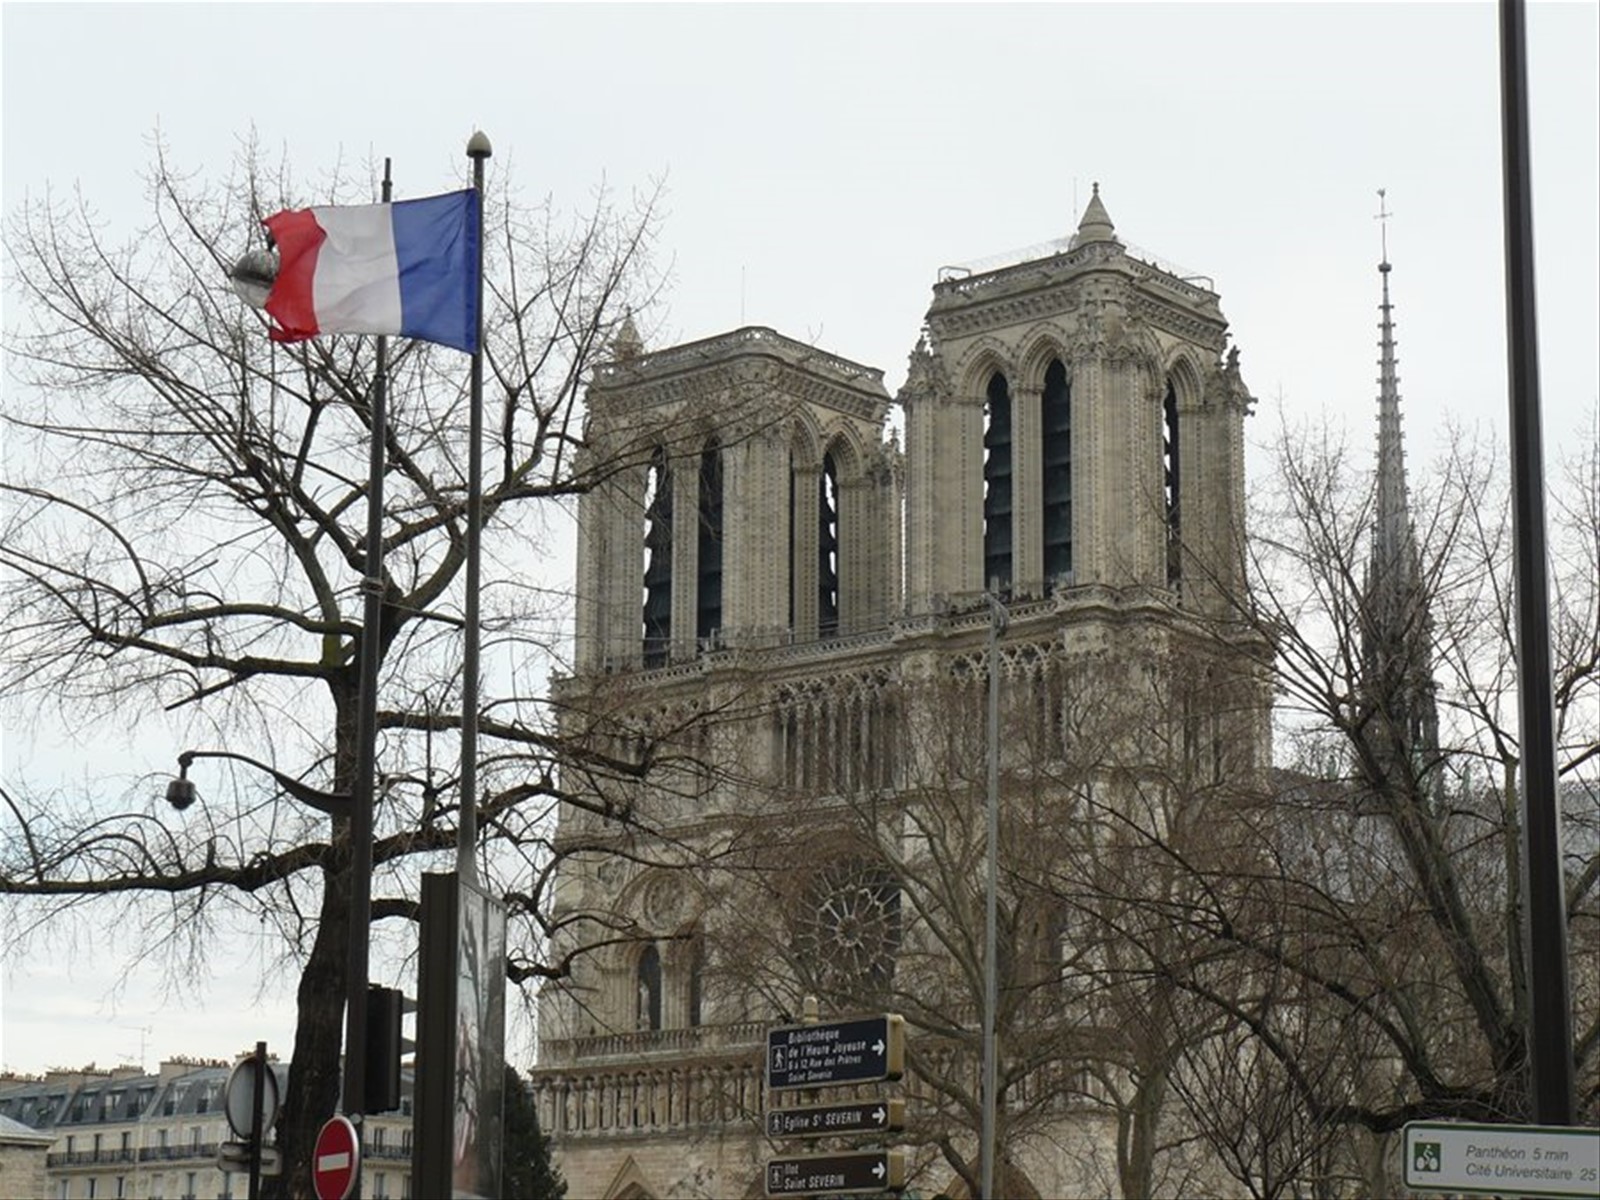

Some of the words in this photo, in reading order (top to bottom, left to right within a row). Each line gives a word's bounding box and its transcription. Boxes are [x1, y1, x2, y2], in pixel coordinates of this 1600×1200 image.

[788, 1049, 798, 1059] de
[832, 1041, 866, 1054] Joyeuse
[1465, 1144, 1526, 1160] Panthéon
[1532, 1148, 1542, 1160] 5
[1544, 1149, 1569, 1160] min
[1465, 1162, 1492, 1177] Cité
[1494, 1164, 1573, 1181] Universitaire
[1579, 1168, 1597, 1182] 25
[784, 1177, 806, 1190] Saint
